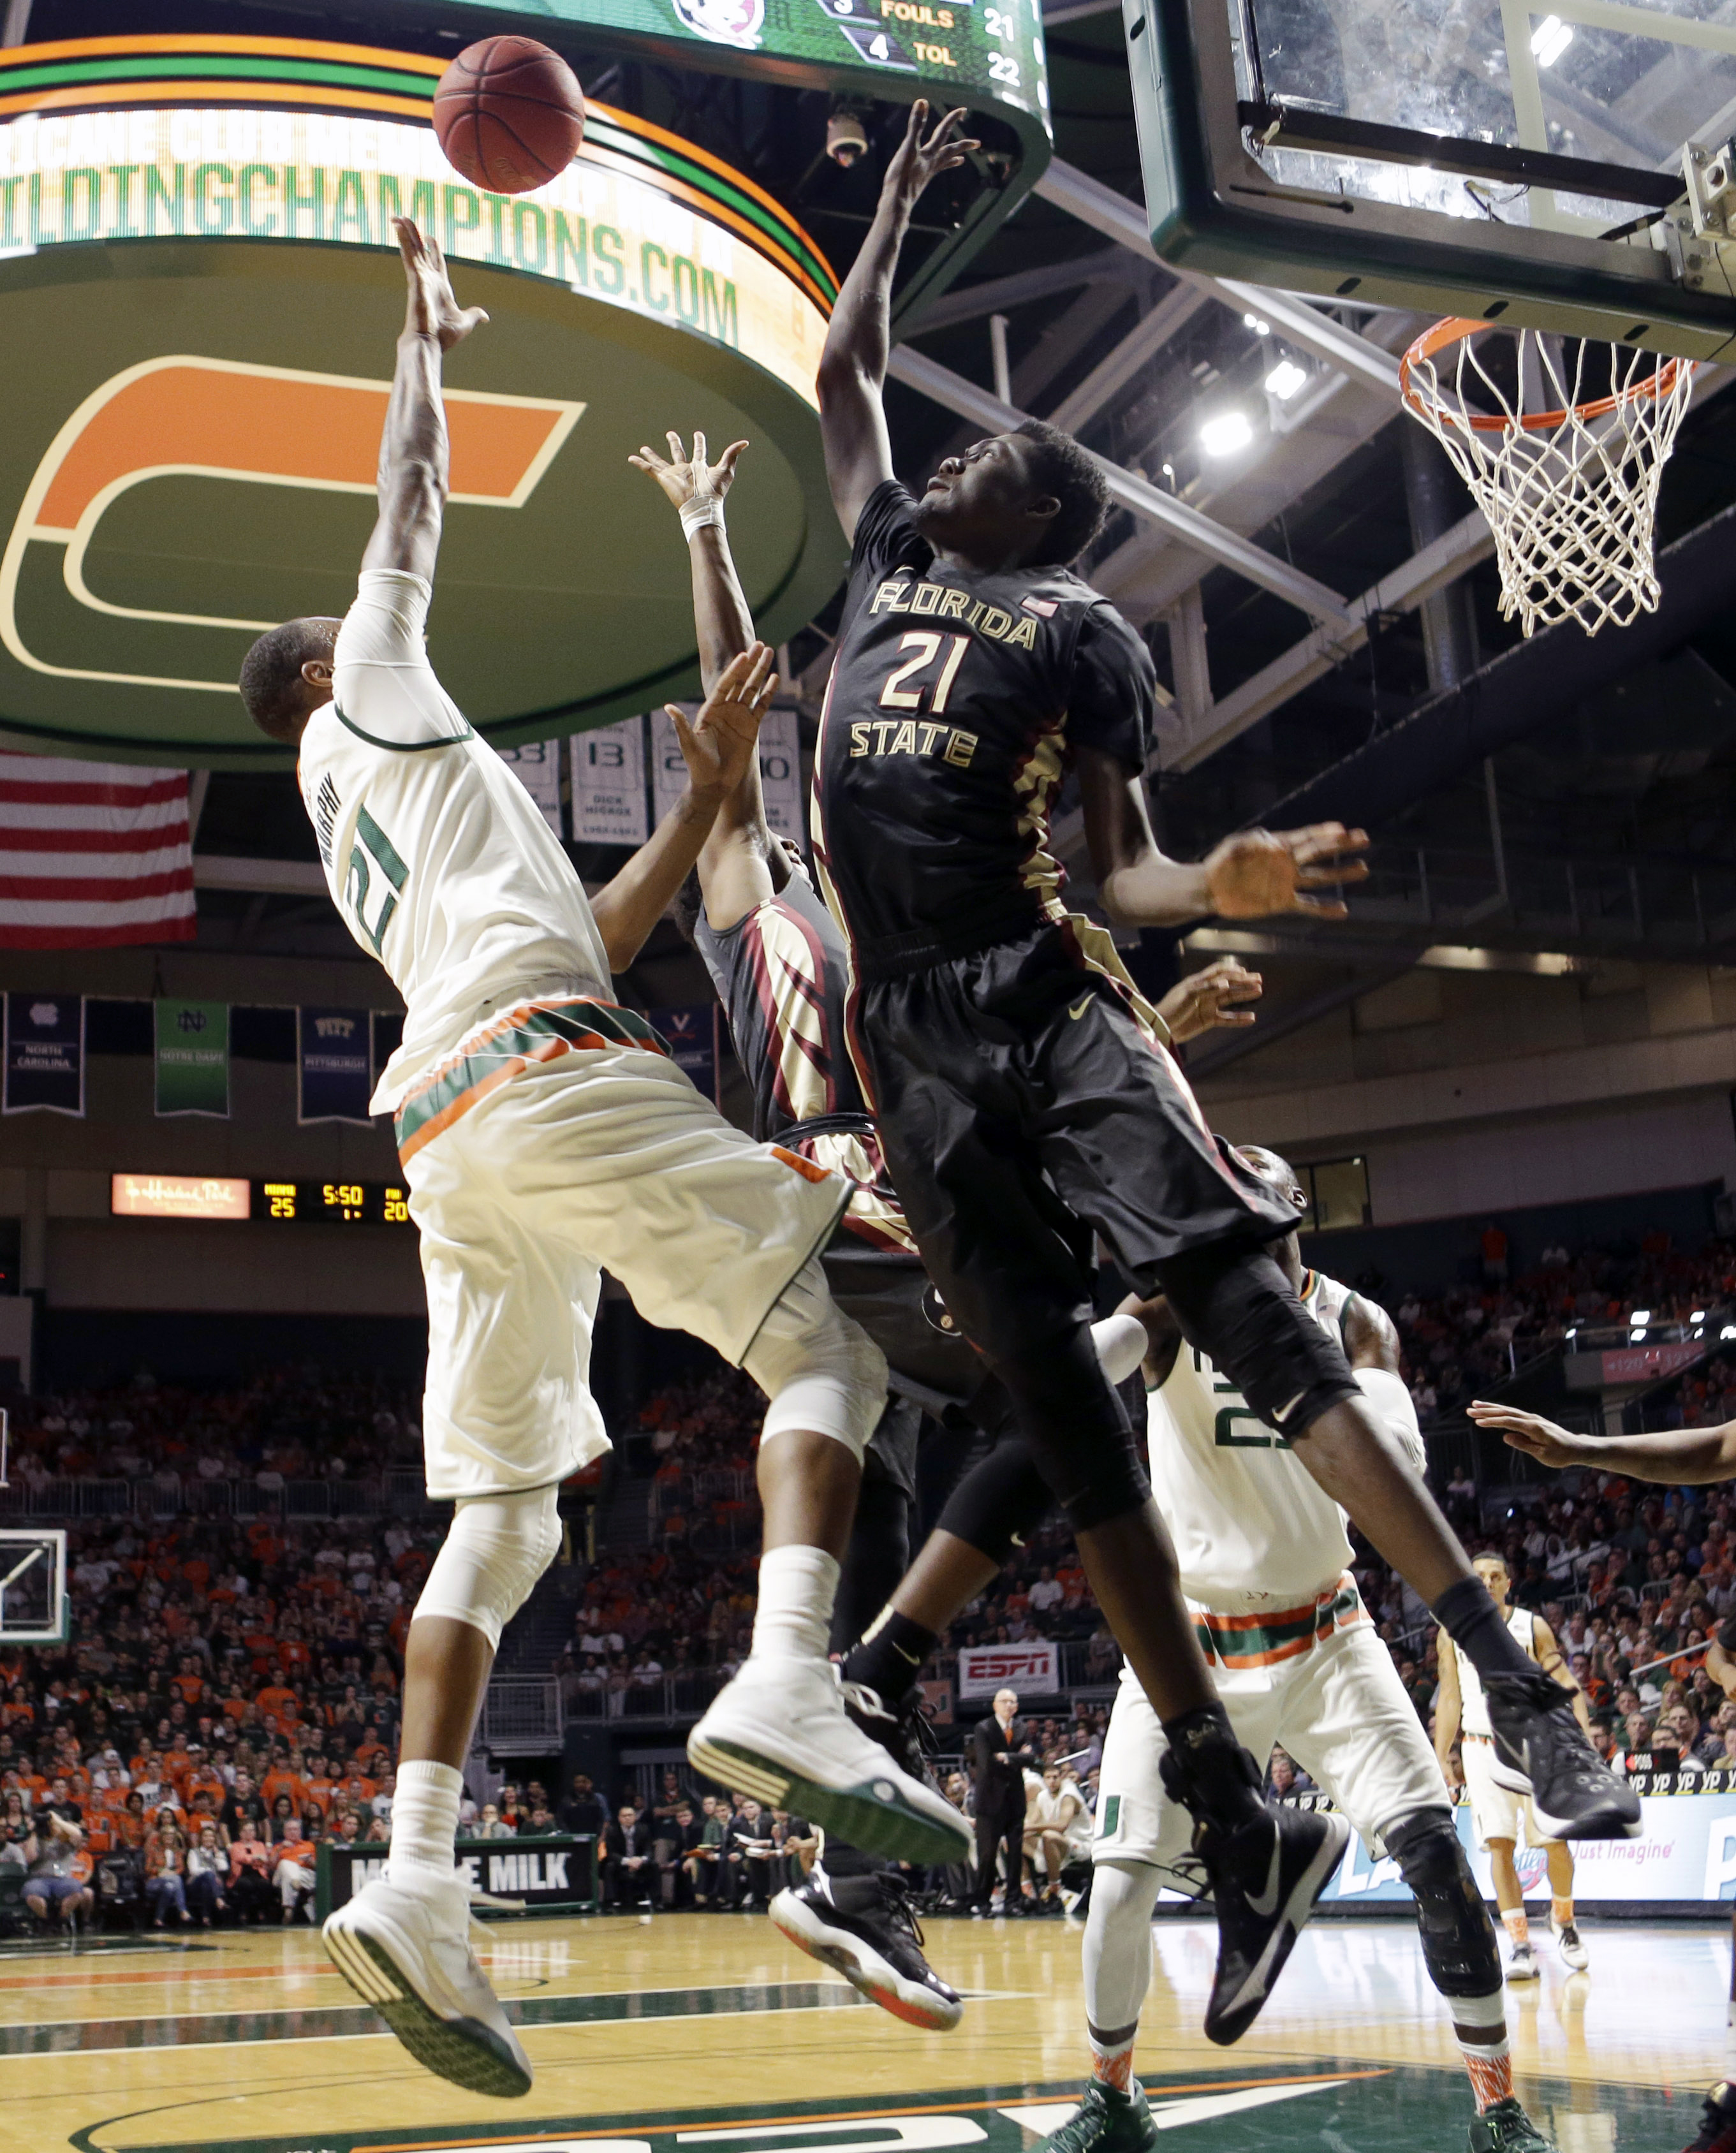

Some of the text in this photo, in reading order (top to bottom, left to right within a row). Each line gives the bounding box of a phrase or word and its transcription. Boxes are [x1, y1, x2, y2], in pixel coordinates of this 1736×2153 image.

[881, 0, 955, 28] FOULS
[983, 8, 1014, 42] 21
[869, 34, 890, 60] 4
[913, 42, 956, 66] TOL
[987, 52, 1020, 87] 22
[869, 582, 1038, 651] FLORIDA
[878, 629, 971, 714] 21
[589, 742, 624, 767] 13
[850, 720, 979, 768] STATE
[317, 771, 341, 869] MURPHY
[348, 802, 410, 957] 21
[314, 1017, 355, 1038] PITT
[17, 1057, 70, 1068] CAROLINA
[26, 1044, 63, 1056] NORTH
[270, 1197, 295, 1217] 25
[323, 1184, 363, 1205] 5:50
[384, 1201, 408, 1221] 20
[967, 1652, 1049, 1679] ESPN
[1607, 1839, 1675, 1865] Imagine
[489, 1851, 571, 1893] MILK
